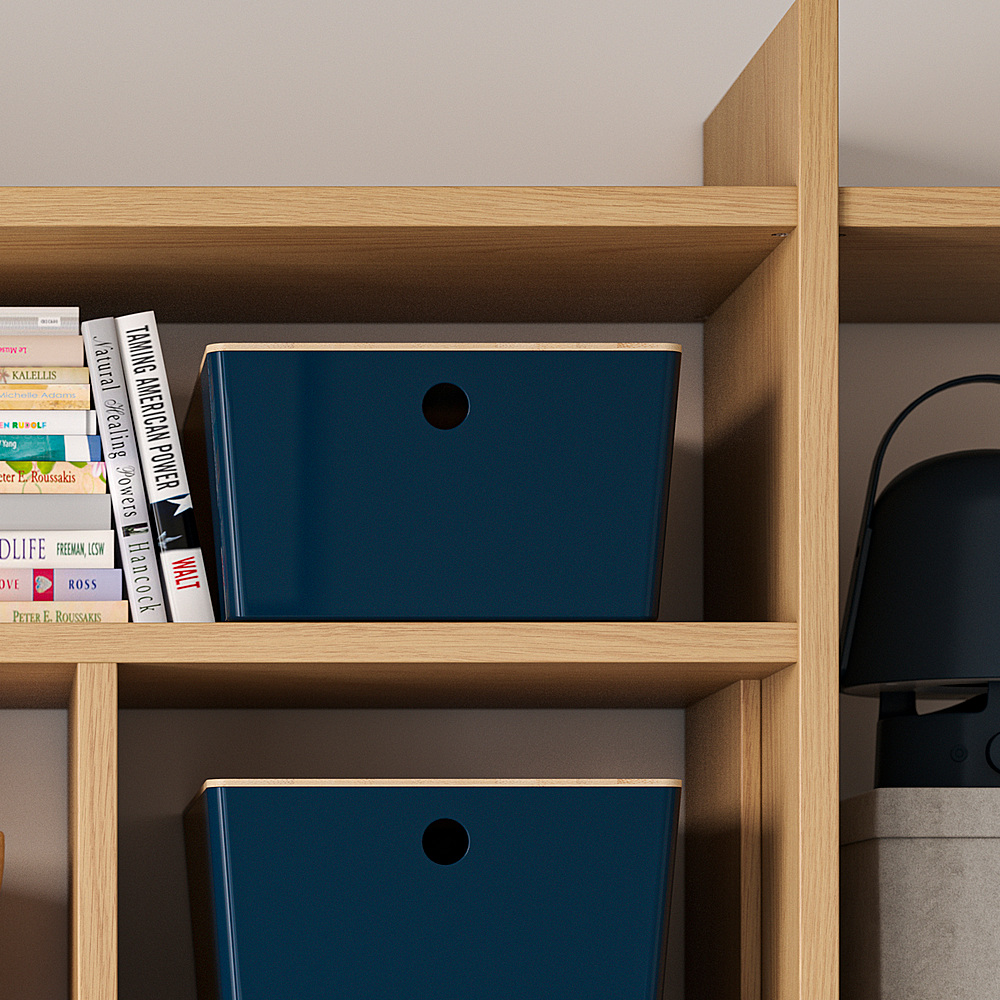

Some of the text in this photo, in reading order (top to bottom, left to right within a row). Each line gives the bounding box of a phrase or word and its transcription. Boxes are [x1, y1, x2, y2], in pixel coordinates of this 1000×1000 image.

[18, 346, 27, 354] Le
[11, 370, 57, 380] KALELLIS
[40, 391, 77, 399] Adams
[125, 324, 180, 492] TAMING AMERICAN POWER
[12, 421, 47, 429] RUDOLF
[92, 336, 138, 519] Natural Healing Powers
[1, 439, 17, 449] Yang
[30, 470, 76, 484] Roussakis
[56, 541, 105, 558] FREEMAN, LCSW
[128, 541, 162, 613] Hancock
[171, 555, 201, 591] WALT
[68, 578, 97, 590] ROSS
[12, 610, 102, 623] PETER ROUSSAKIS
